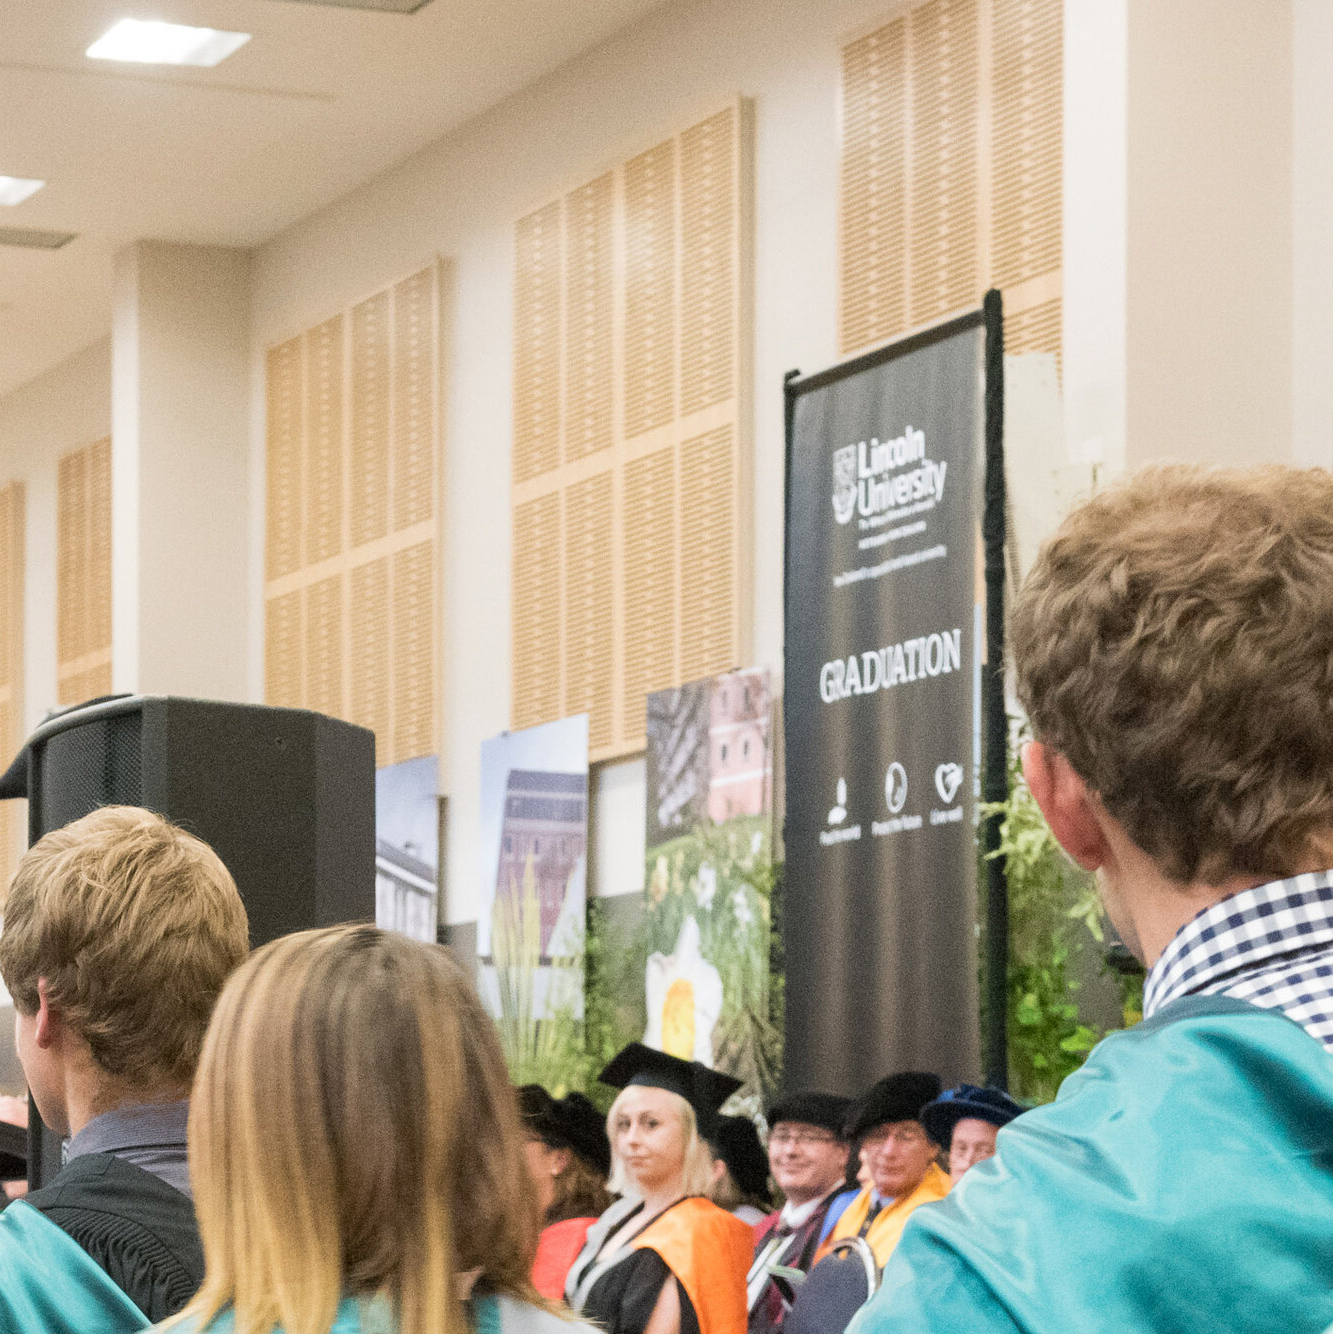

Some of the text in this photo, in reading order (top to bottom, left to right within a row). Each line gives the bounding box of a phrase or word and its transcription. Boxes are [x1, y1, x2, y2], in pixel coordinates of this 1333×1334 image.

[858, 424, 925, 478] Lincoln
[858, 459, 947, 516] University
[820, 629, 961, 704] GRADUATION
